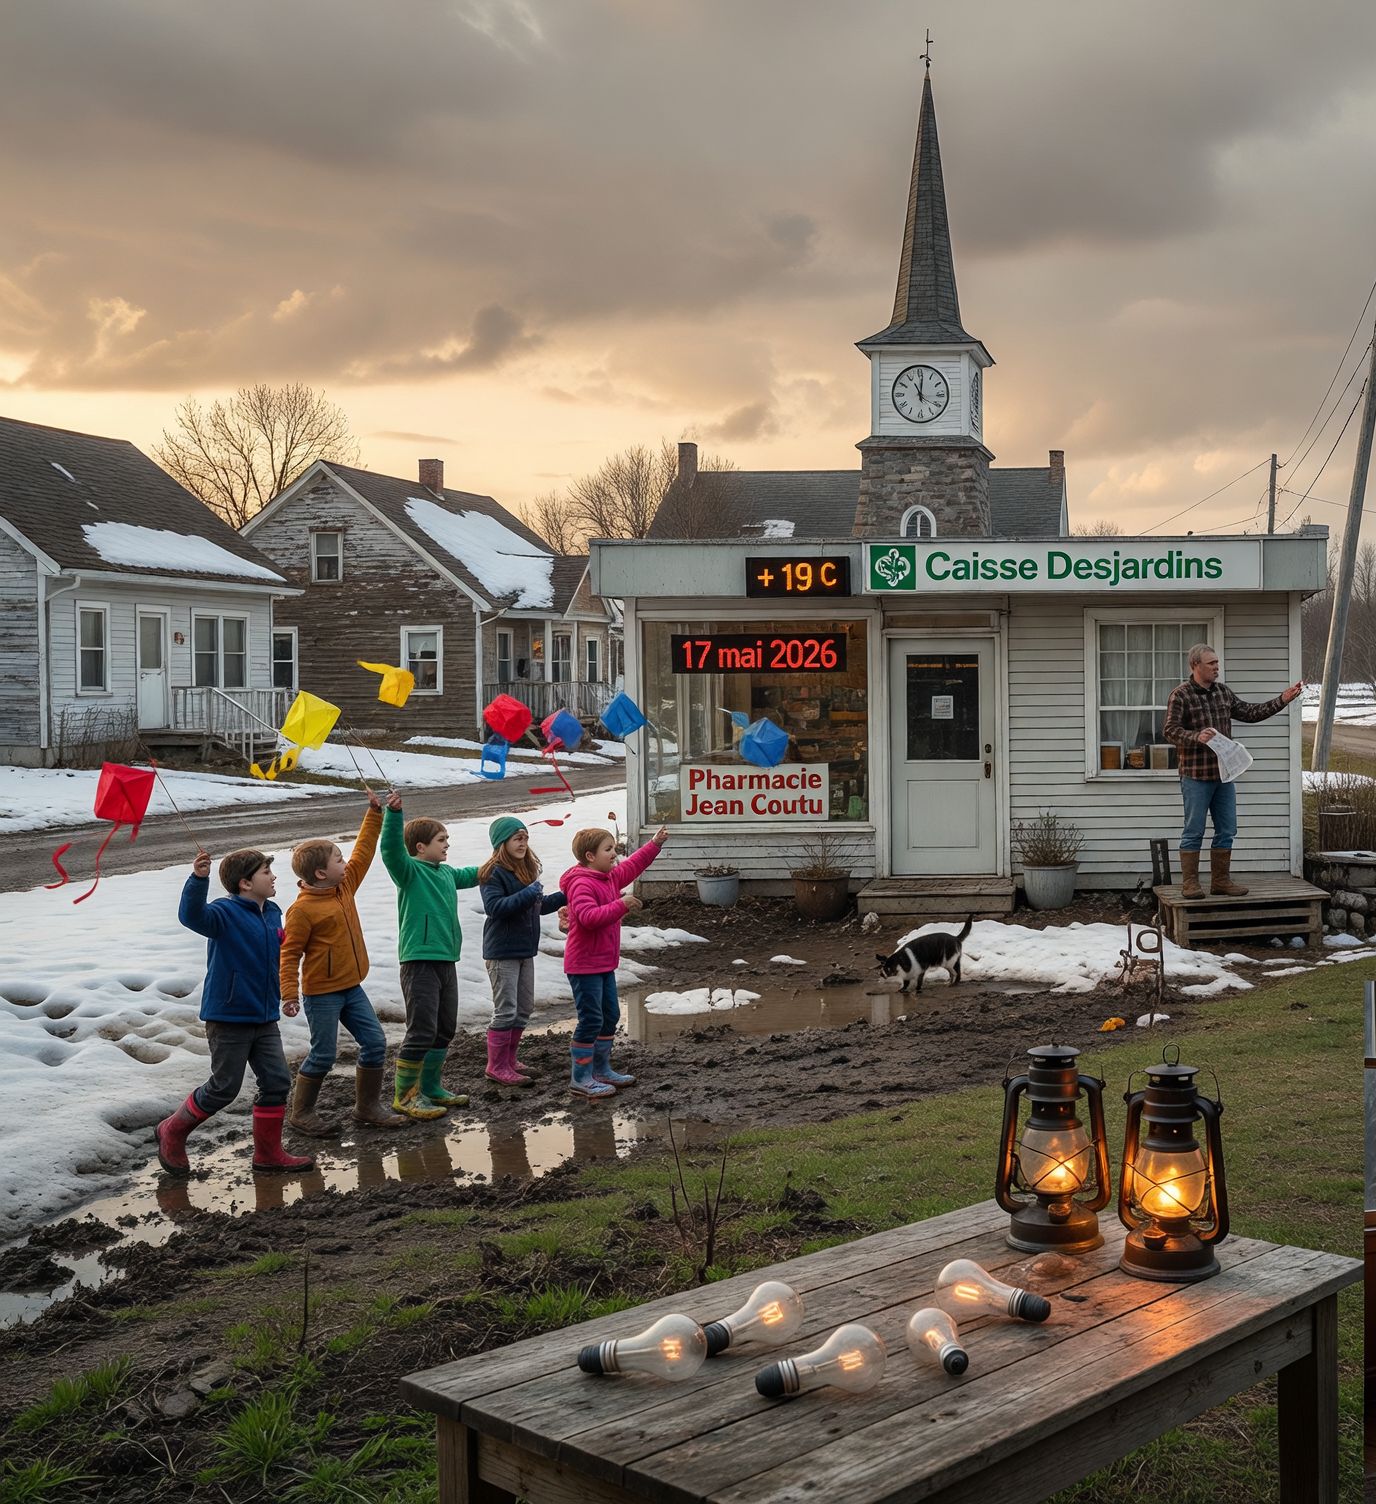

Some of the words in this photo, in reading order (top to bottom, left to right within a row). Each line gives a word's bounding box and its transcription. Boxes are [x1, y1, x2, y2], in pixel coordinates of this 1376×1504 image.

[820, 562, 837, 586] C
[926, 551, 1038, 580] Caisse
[1047, 550, 1223, 586] Desjardins
[682, 640, 712, 668] 17
[718, 640, 763, 668] mai
[770, 639, 837, 668] 2026
[689, 768, 822, 790] Pharmacie
[686, 794, 744, 815] Jean
[750, 794, 823, 815] Coutu
